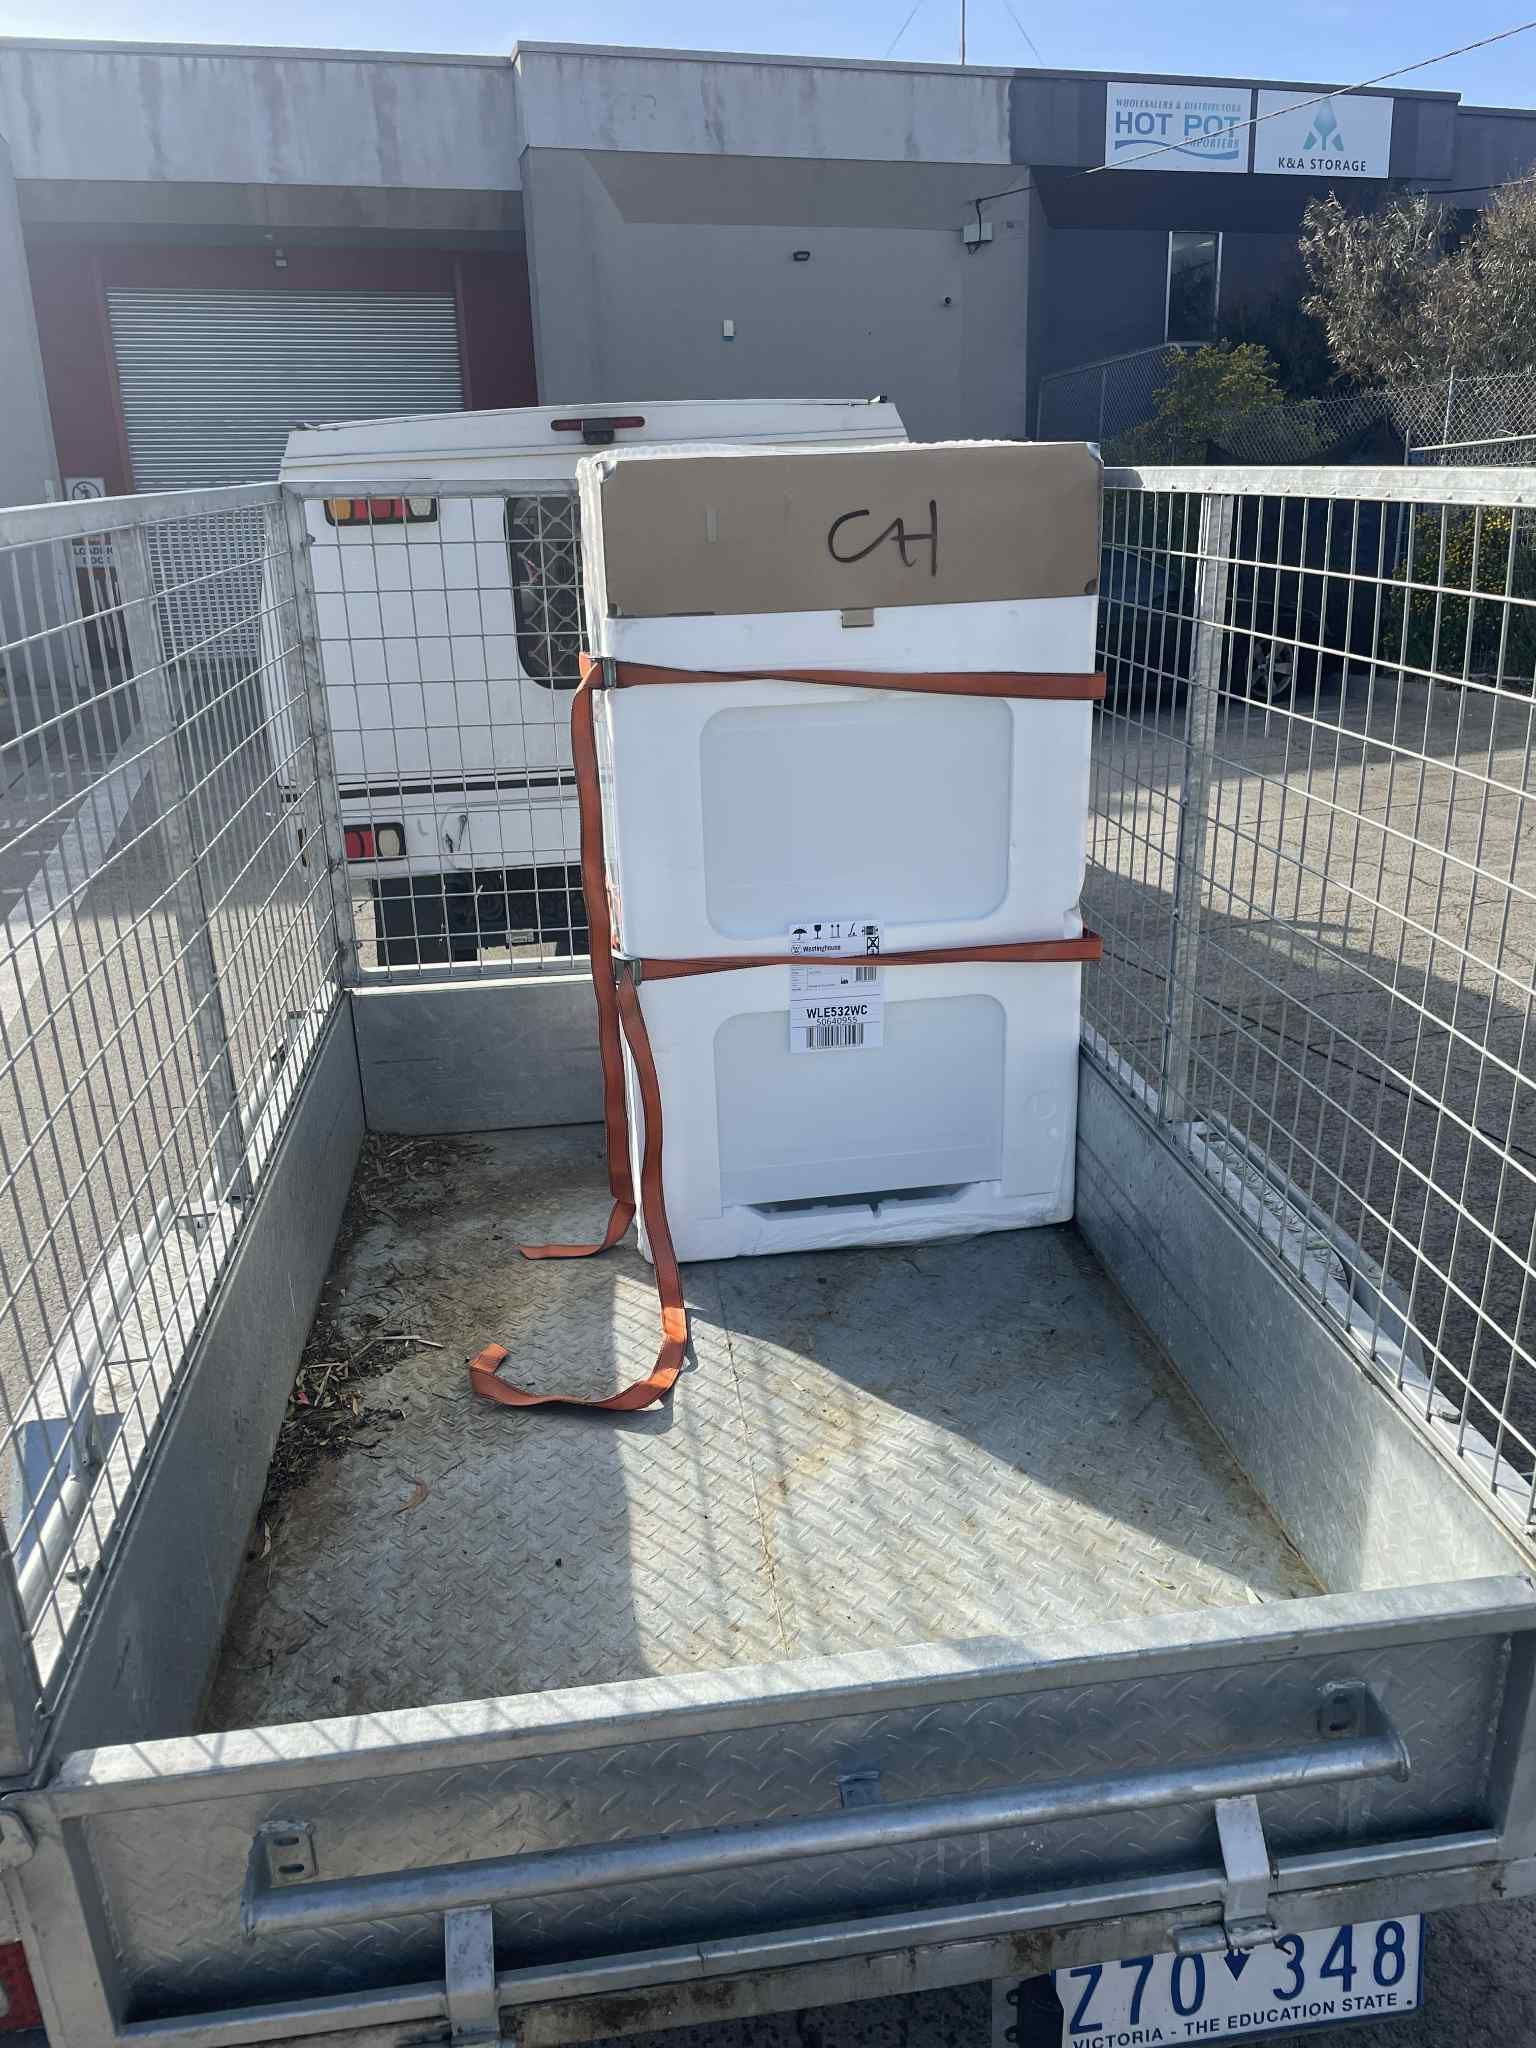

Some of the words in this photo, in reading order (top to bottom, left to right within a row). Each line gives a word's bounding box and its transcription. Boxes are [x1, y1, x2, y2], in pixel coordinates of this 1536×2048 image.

[1115, 111, 1173, 135] HOT
[1184, 113, 1241, 137] POT
[1278, 156, 1305, 169] K&A
[1310, 158, 1367, 172] STORAGE
[803, 944, 841, 953] Westinghouse
[806, 1004, 868, 1019] WLE532WC
[1068, 1952, 1207, 2035] Z70
[1272, 1920, 1406, 2002] 348
[1073, 2027, 1163, 2048] VICTORIA
[1183, 2017, 1221, 2037] THE
[1227, 1999, 1336, 2029] EDUCATION
[1341, 1991, 1398, 2014] STATE
